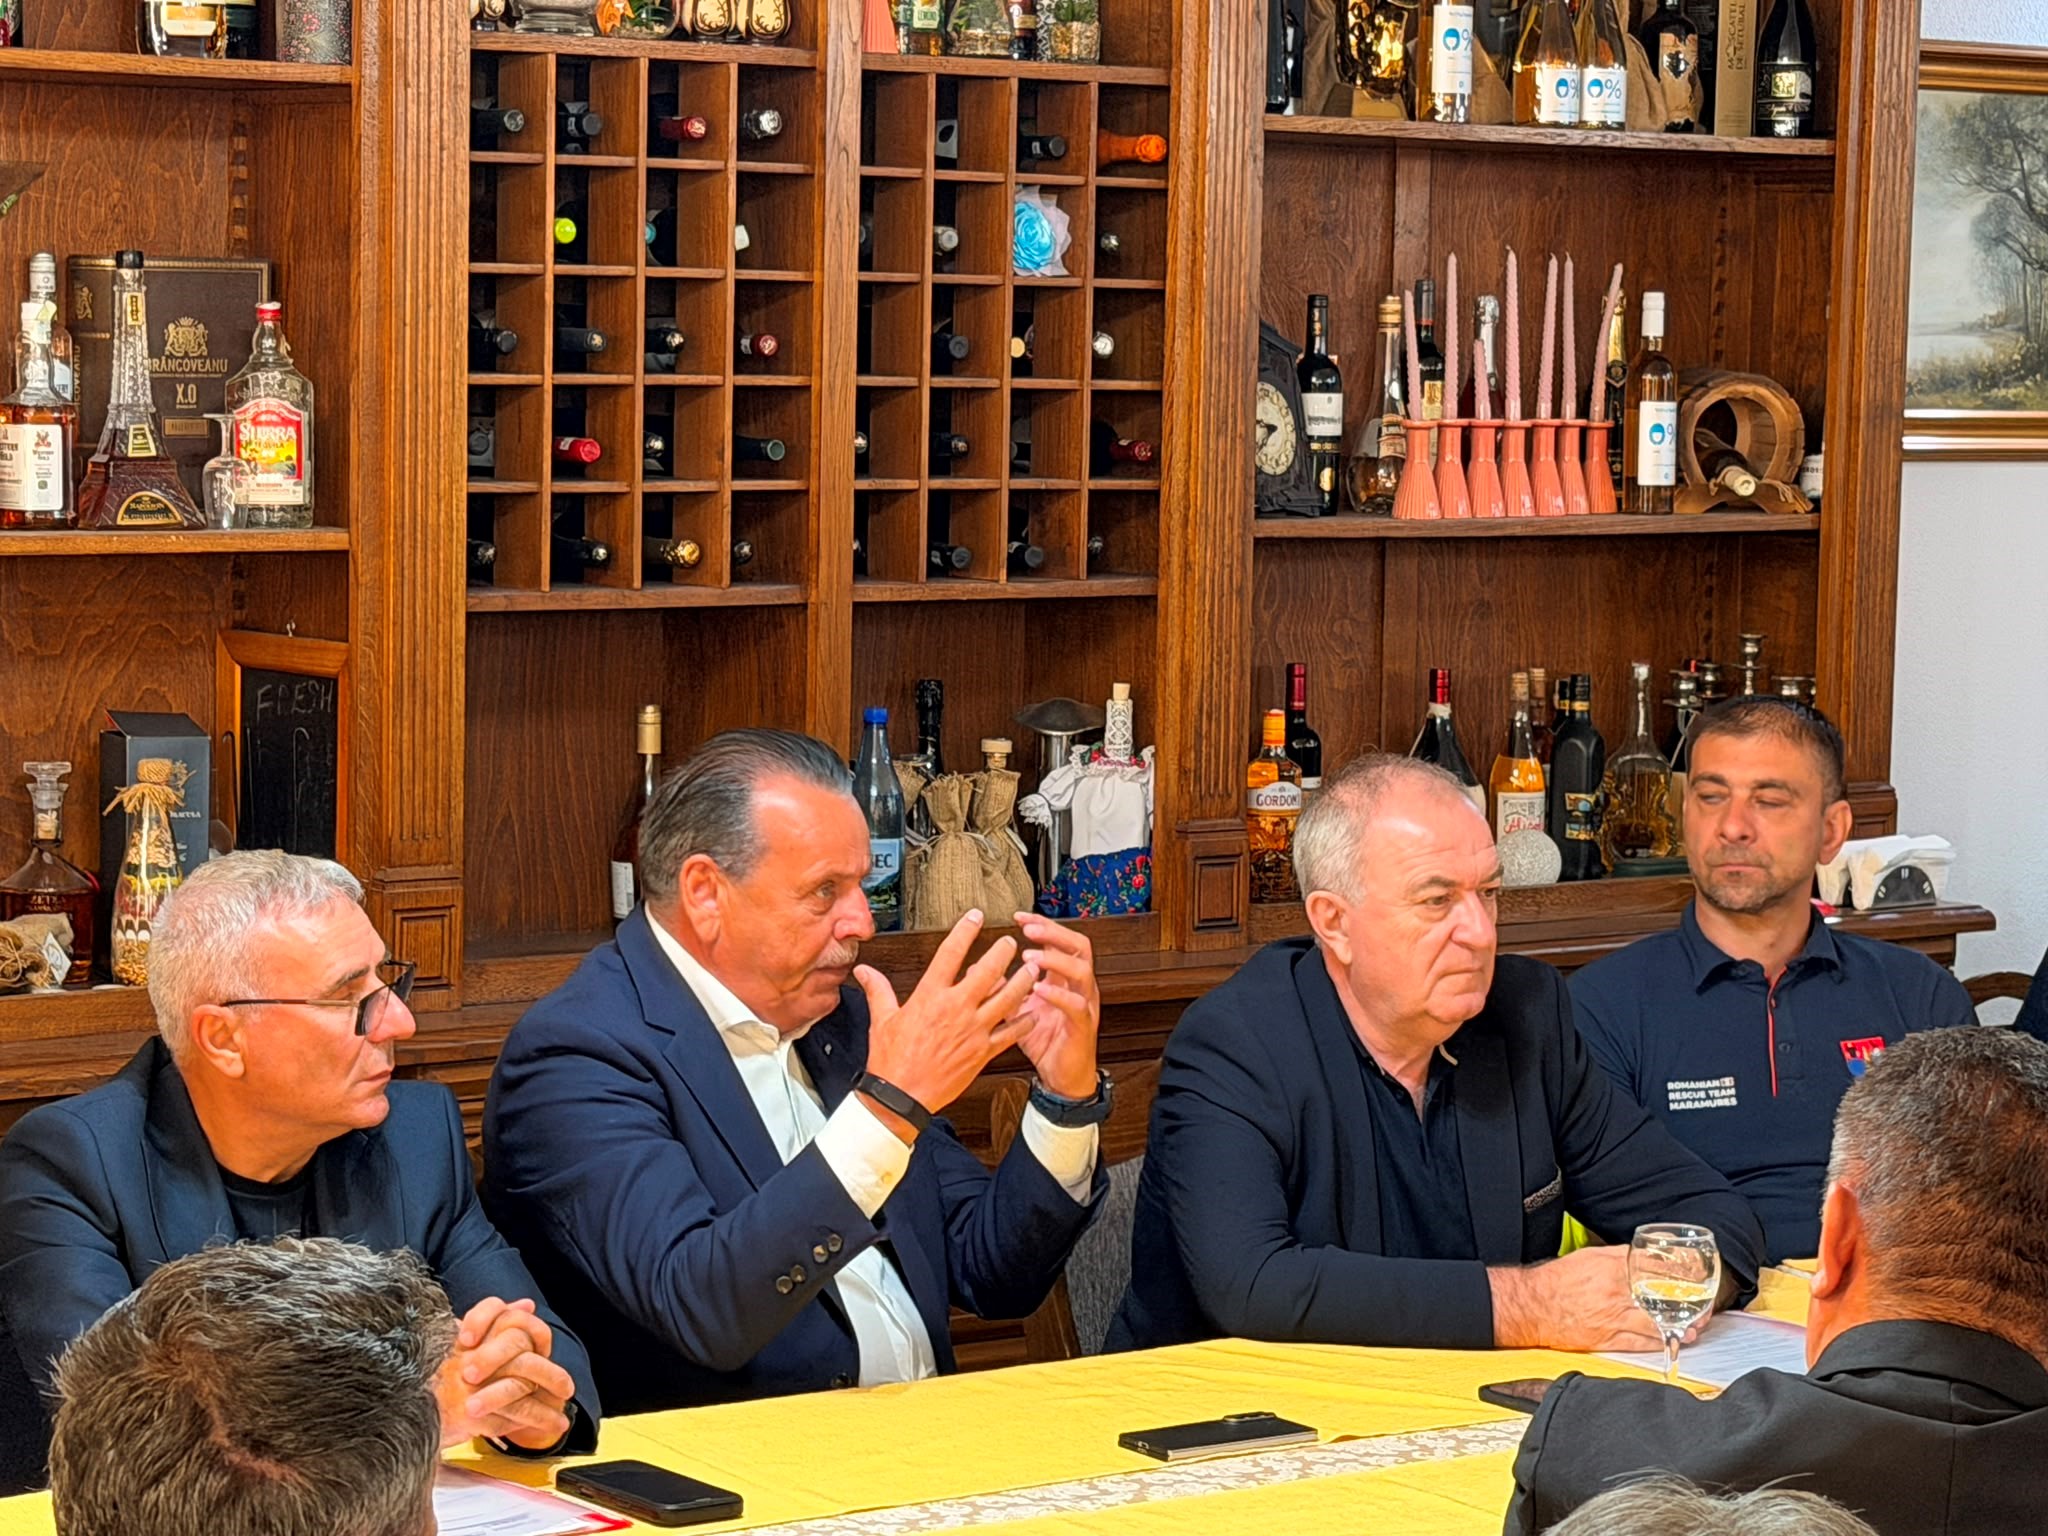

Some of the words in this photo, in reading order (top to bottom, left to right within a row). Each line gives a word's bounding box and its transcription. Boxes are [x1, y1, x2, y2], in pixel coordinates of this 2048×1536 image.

[1667, 1080, 1720, 1090] ROMANIAN
[1668, 1090, 1706, 1100] RESCUE
[1708, 1087, 1736, 1097] TEAM
[1669, 1097, 1737, 1110] MARAMURES
